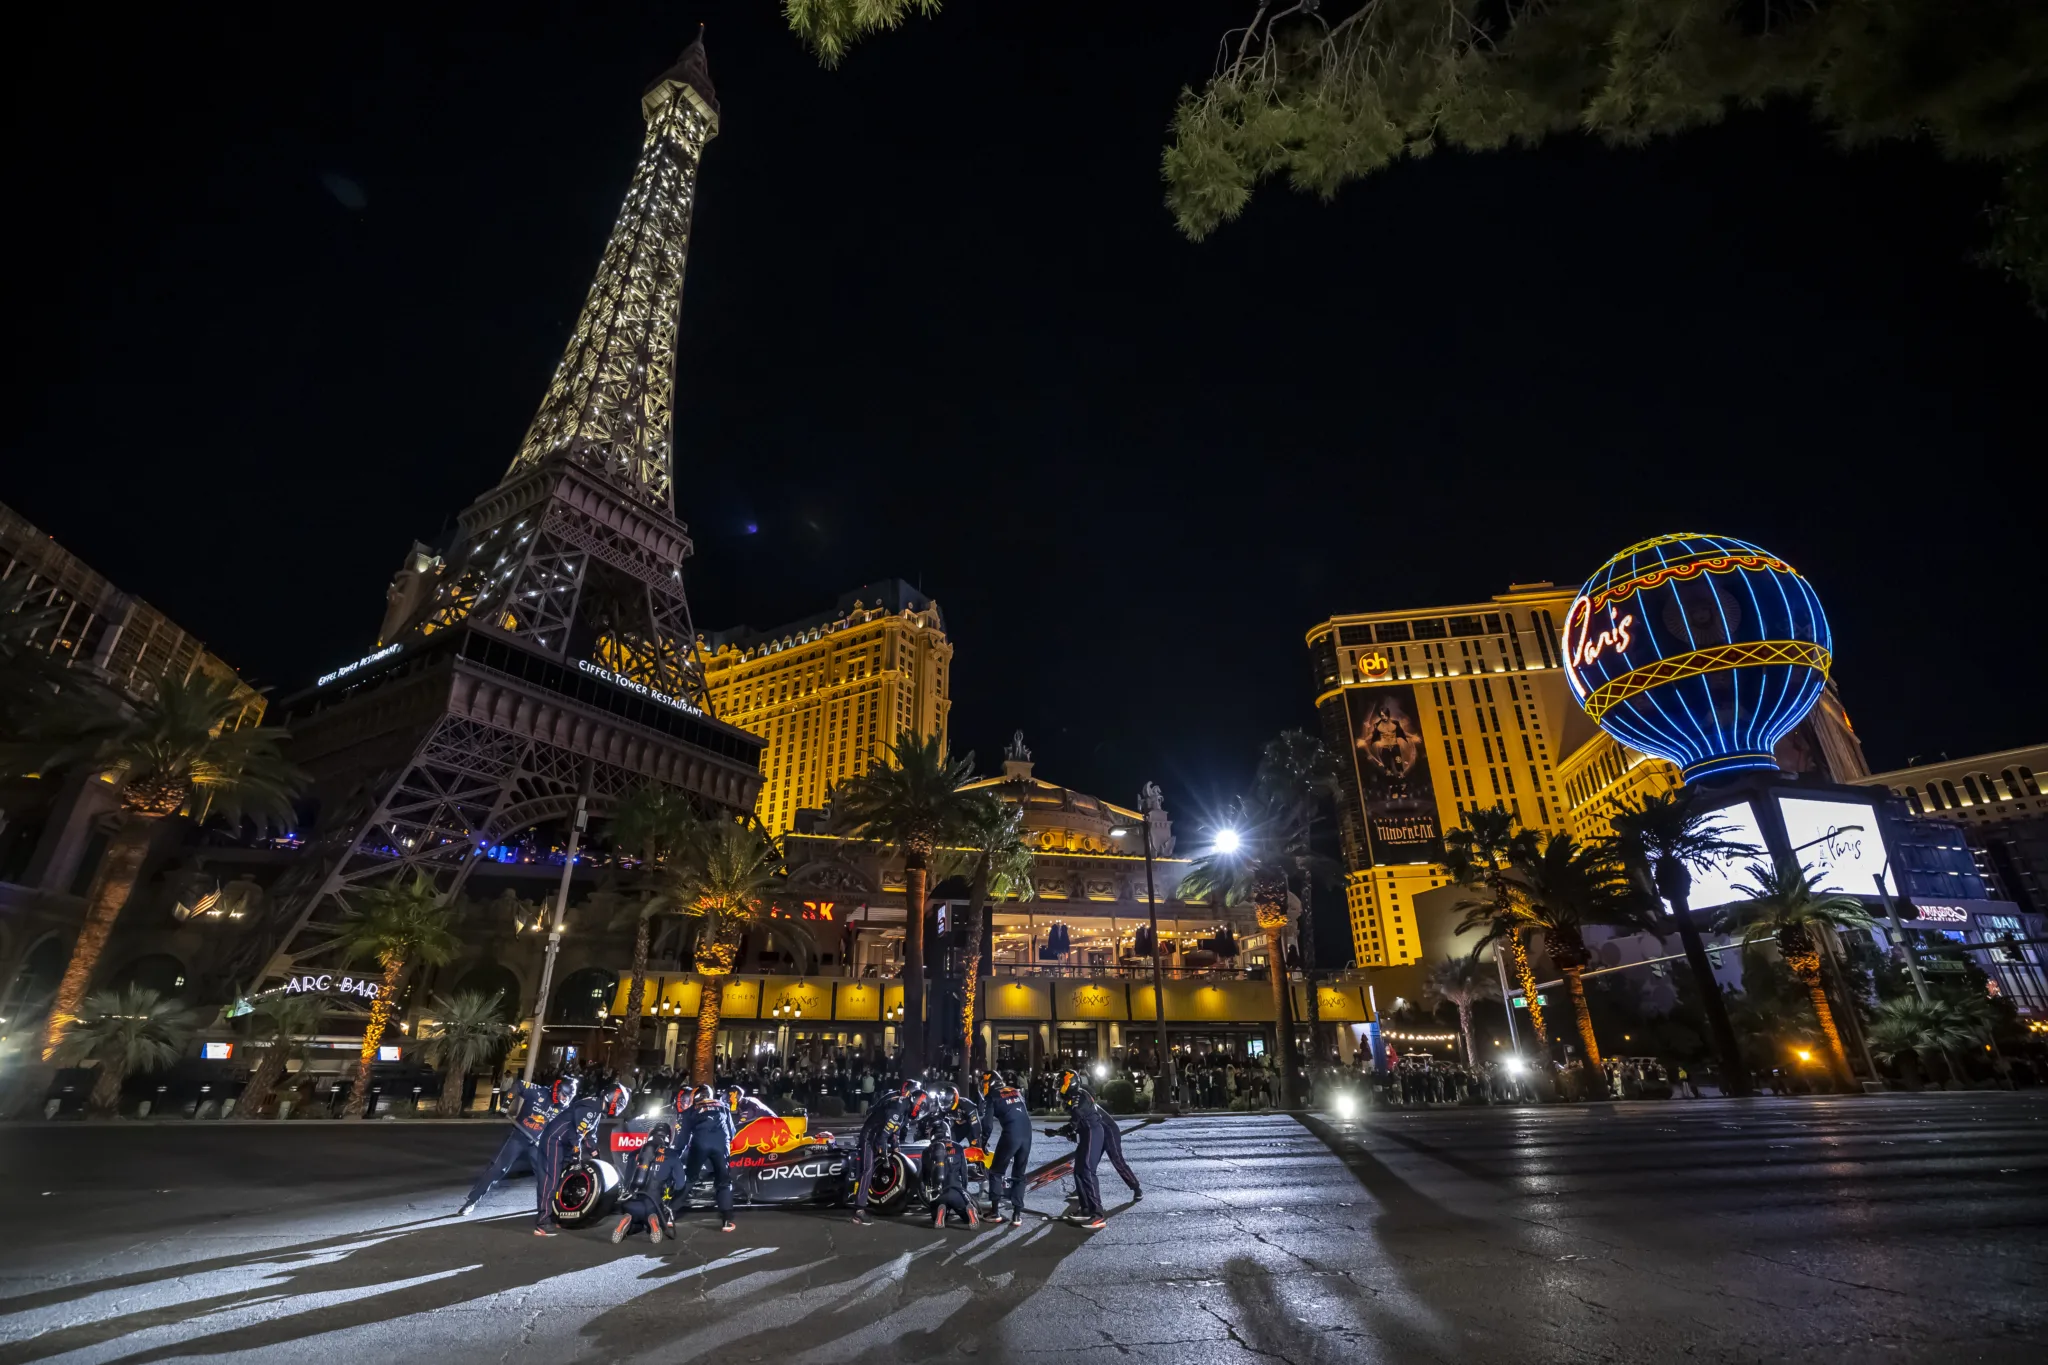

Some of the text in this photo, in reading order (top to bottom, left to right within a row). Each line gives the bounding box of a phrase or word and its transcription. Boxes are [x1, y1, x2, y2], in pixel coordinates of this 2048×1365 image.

[1562, 595, 1632, 698] Paris
[338, 661, 359, 678] TOWER
[1362, 651, 1388, 673] ph
[578, 660, 703, 718] EIFFEL TOWER RESTAURANT
[1827, 825, 1862, 860] Paris
[286, 974, 379, 1000] ARC BAR
[730, 1156, 744, 1168] ed
[758, 1163, 842, 1181] ORACLE
